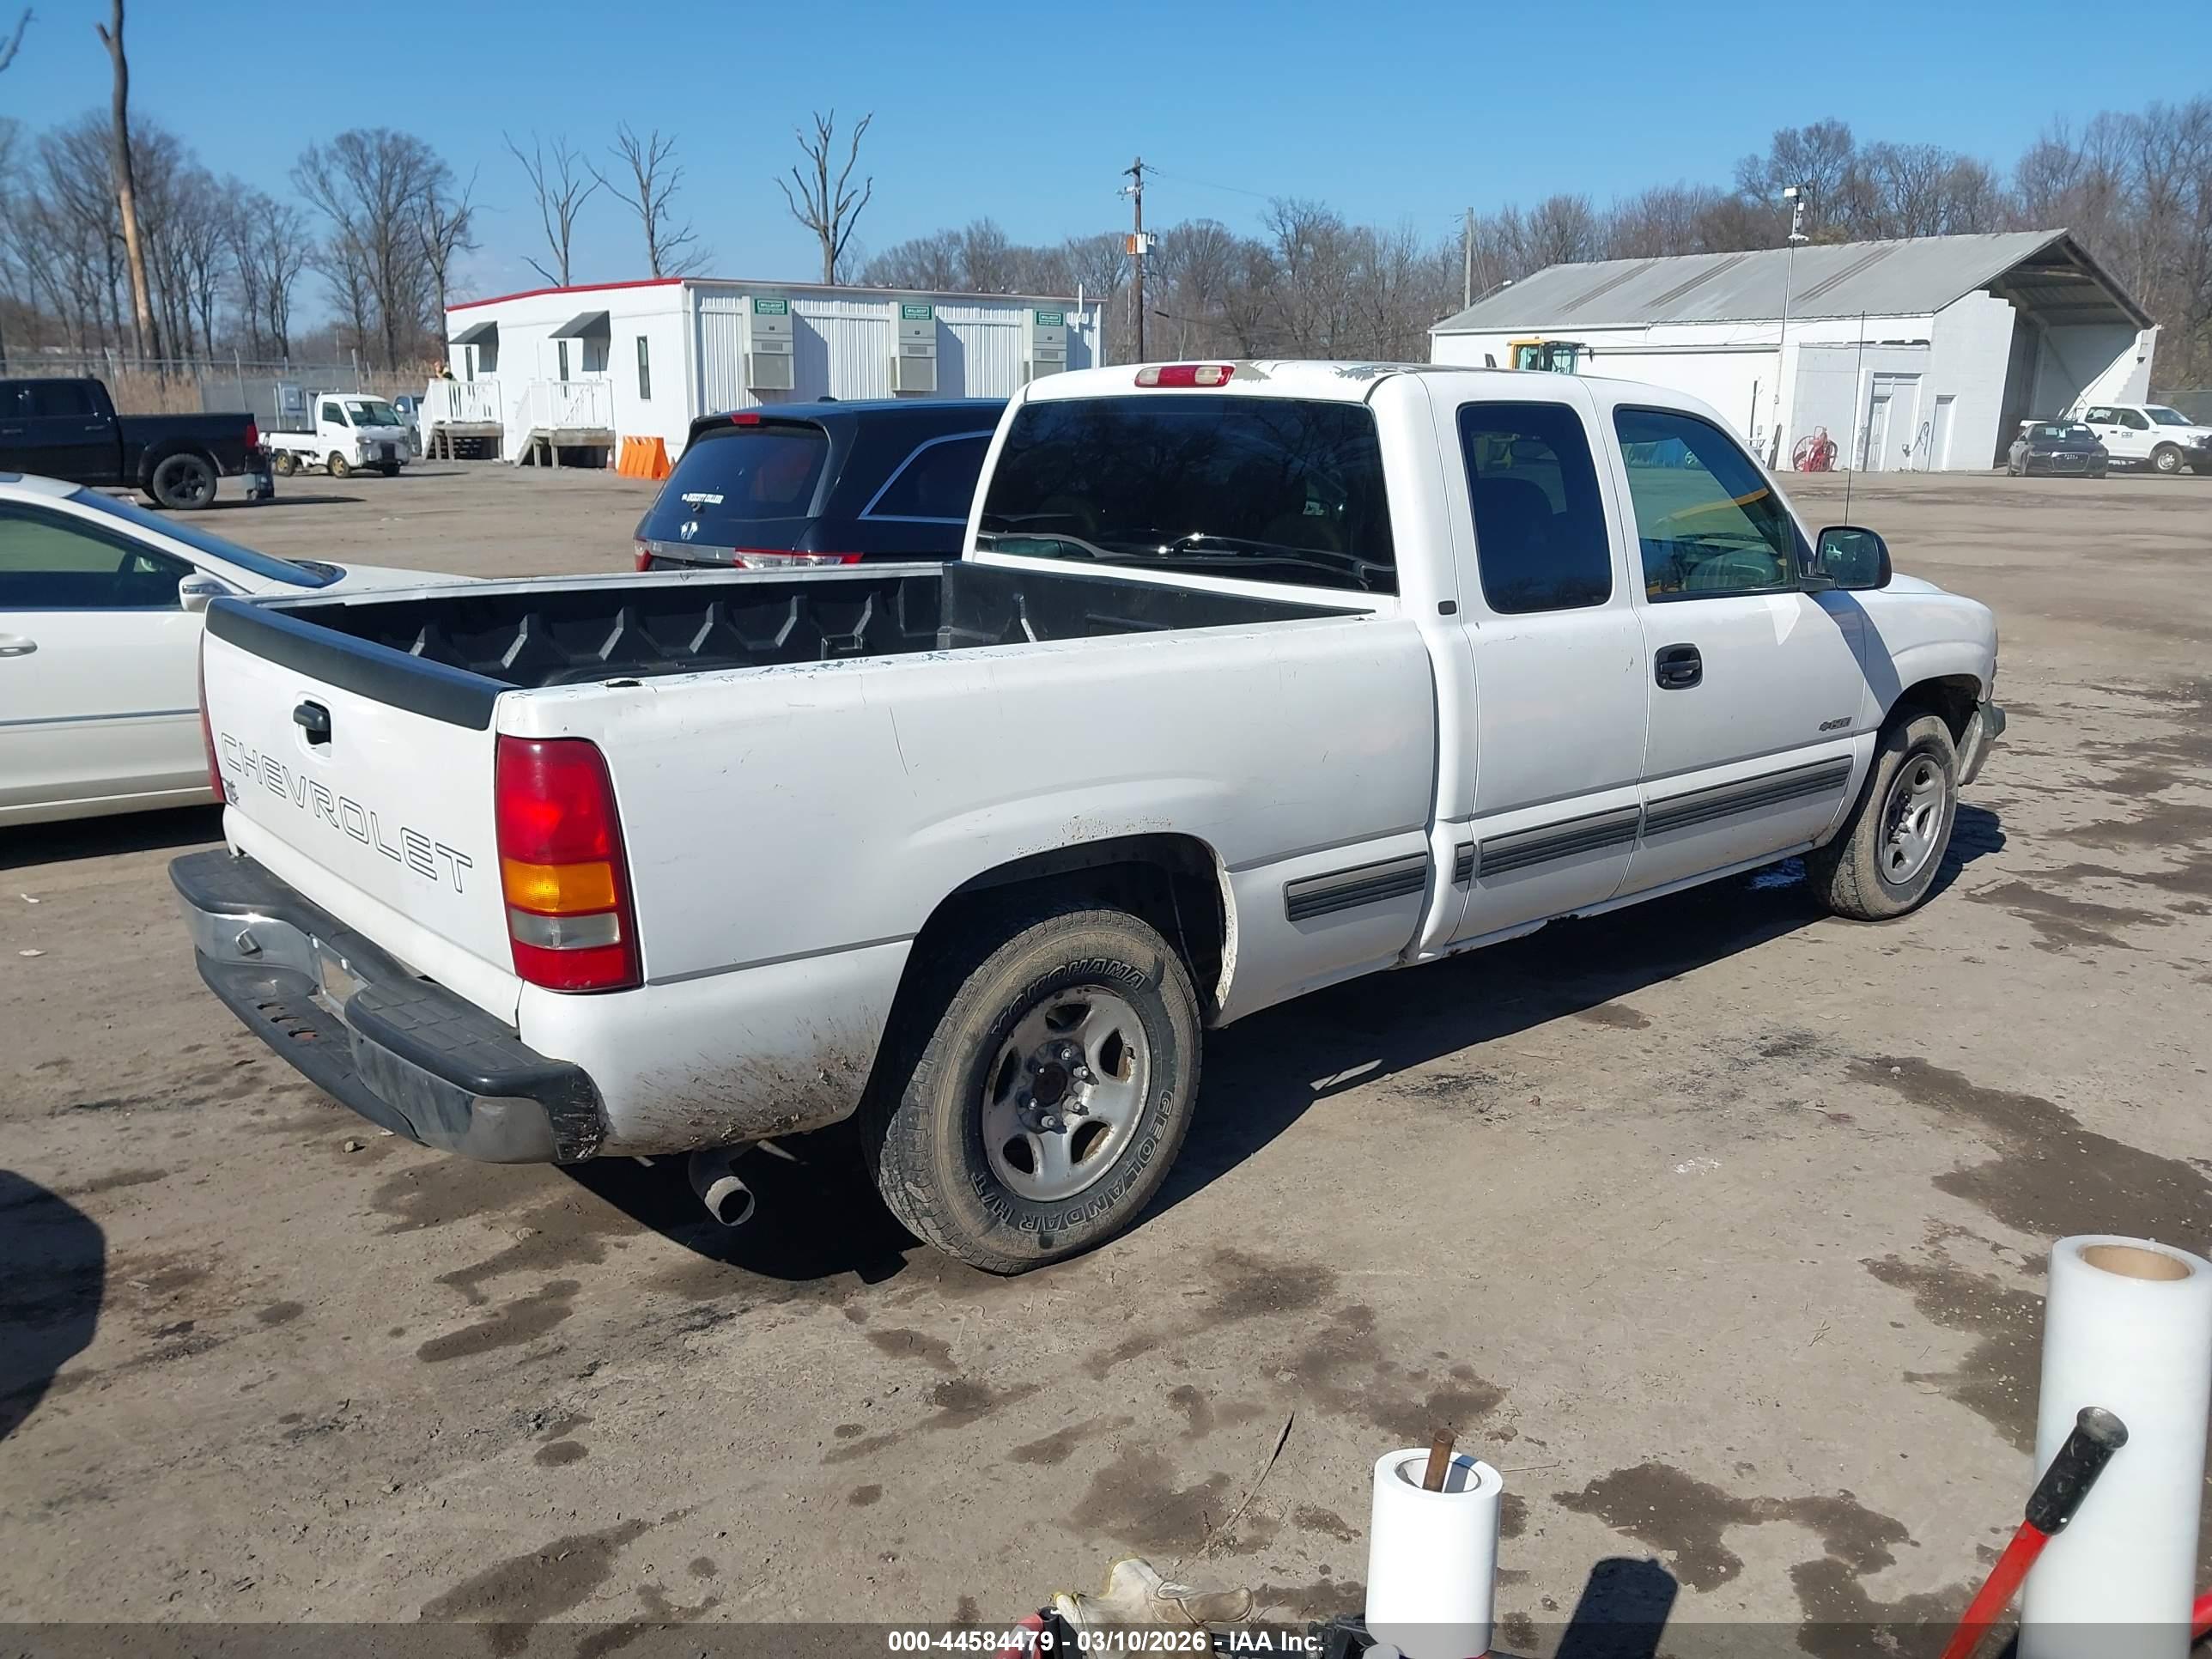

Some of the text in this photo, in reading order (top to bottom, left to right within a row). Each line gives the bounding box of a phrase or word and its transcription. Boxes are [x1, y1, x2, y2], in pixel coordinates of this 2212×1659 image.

[221, 732, 473, 894] CHEVROLET
[970, 1089, 1174, 1232] GEOLANDAR H/T
